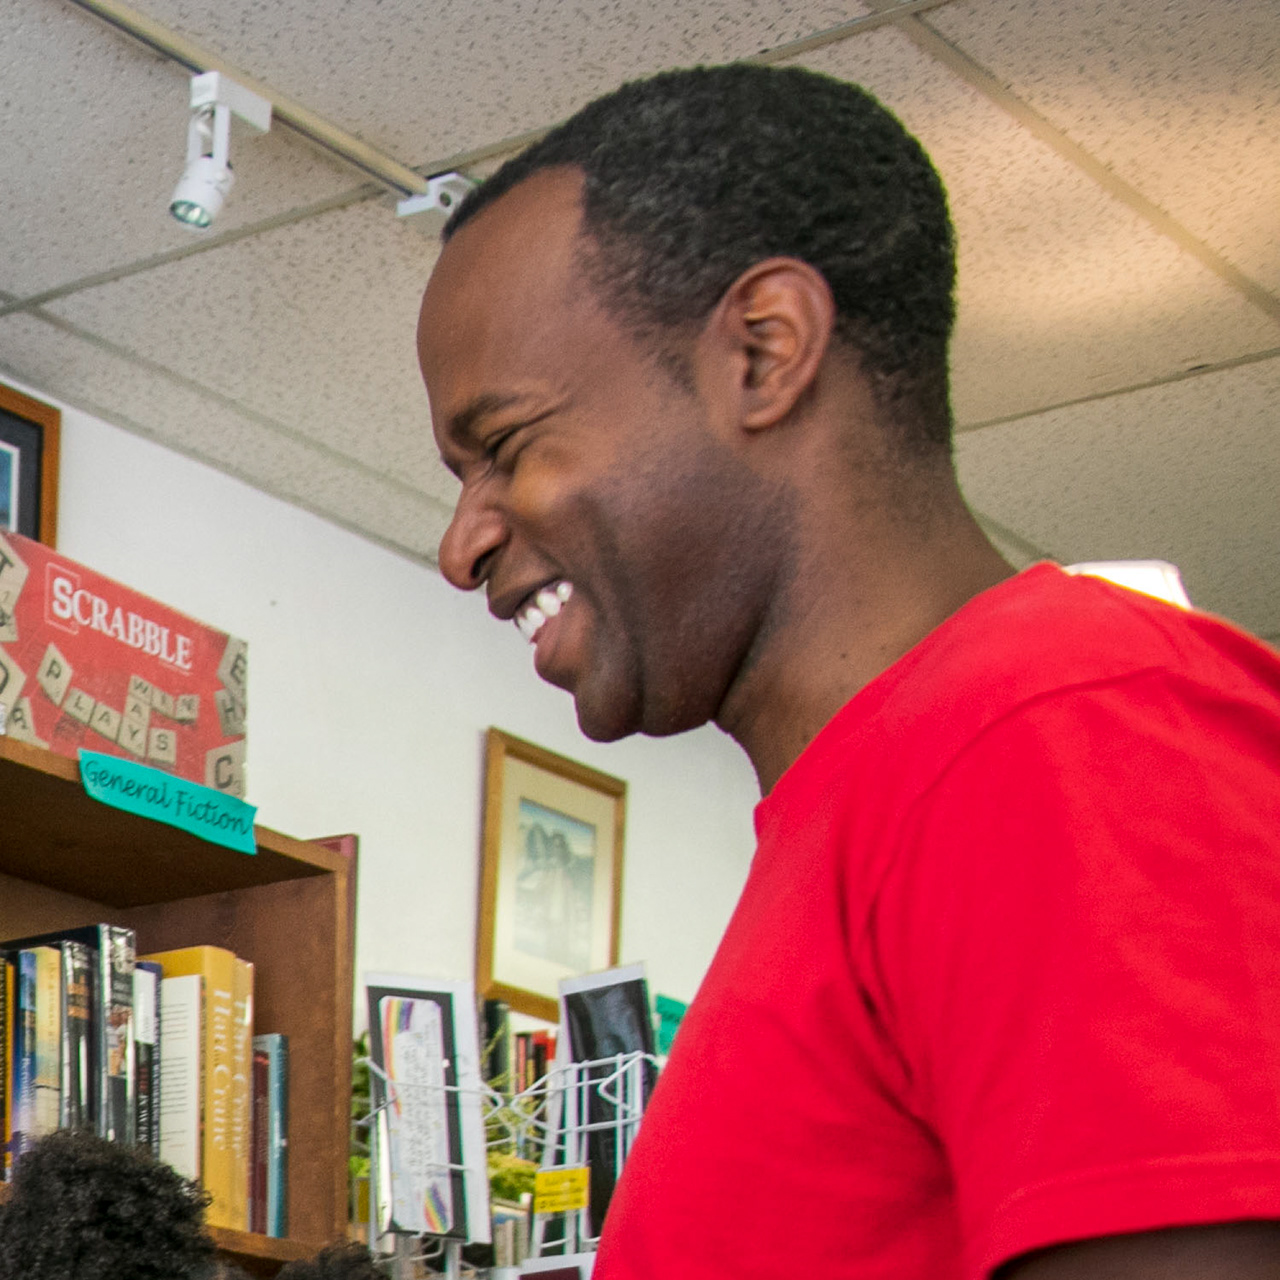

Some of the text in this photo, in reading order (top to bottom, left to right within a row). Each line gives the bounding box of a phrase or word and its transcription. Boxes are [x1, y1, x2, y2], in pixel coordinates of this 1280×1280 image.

[52, 575, 193, 670] SCRABBLE
[84, 759, 251, 836] General Fiction
[212, 1064, 232, 1151] Crane
